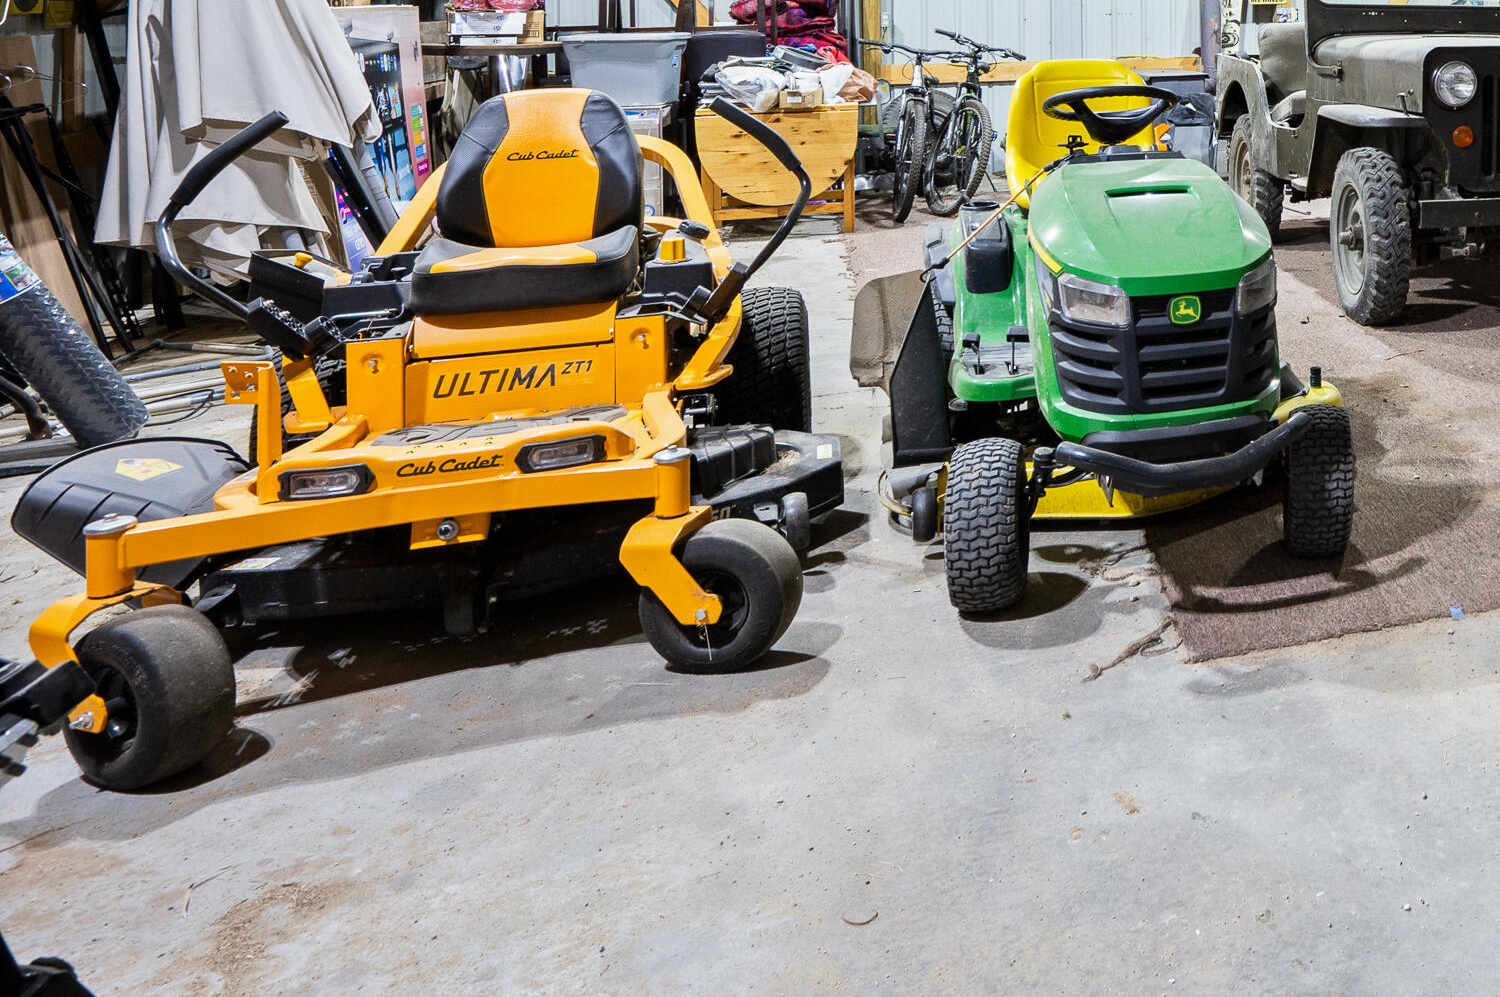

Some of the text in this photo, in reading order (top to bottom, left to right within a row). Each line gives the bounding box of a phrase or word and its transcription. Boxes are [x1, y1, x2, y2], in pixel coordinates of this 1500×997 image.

[506, 149, 580, 161] Cub Cadet
[433, 359, 593, 399] ULTIMA ZT1
[396, 454, 504, 478] Cub Cadet
